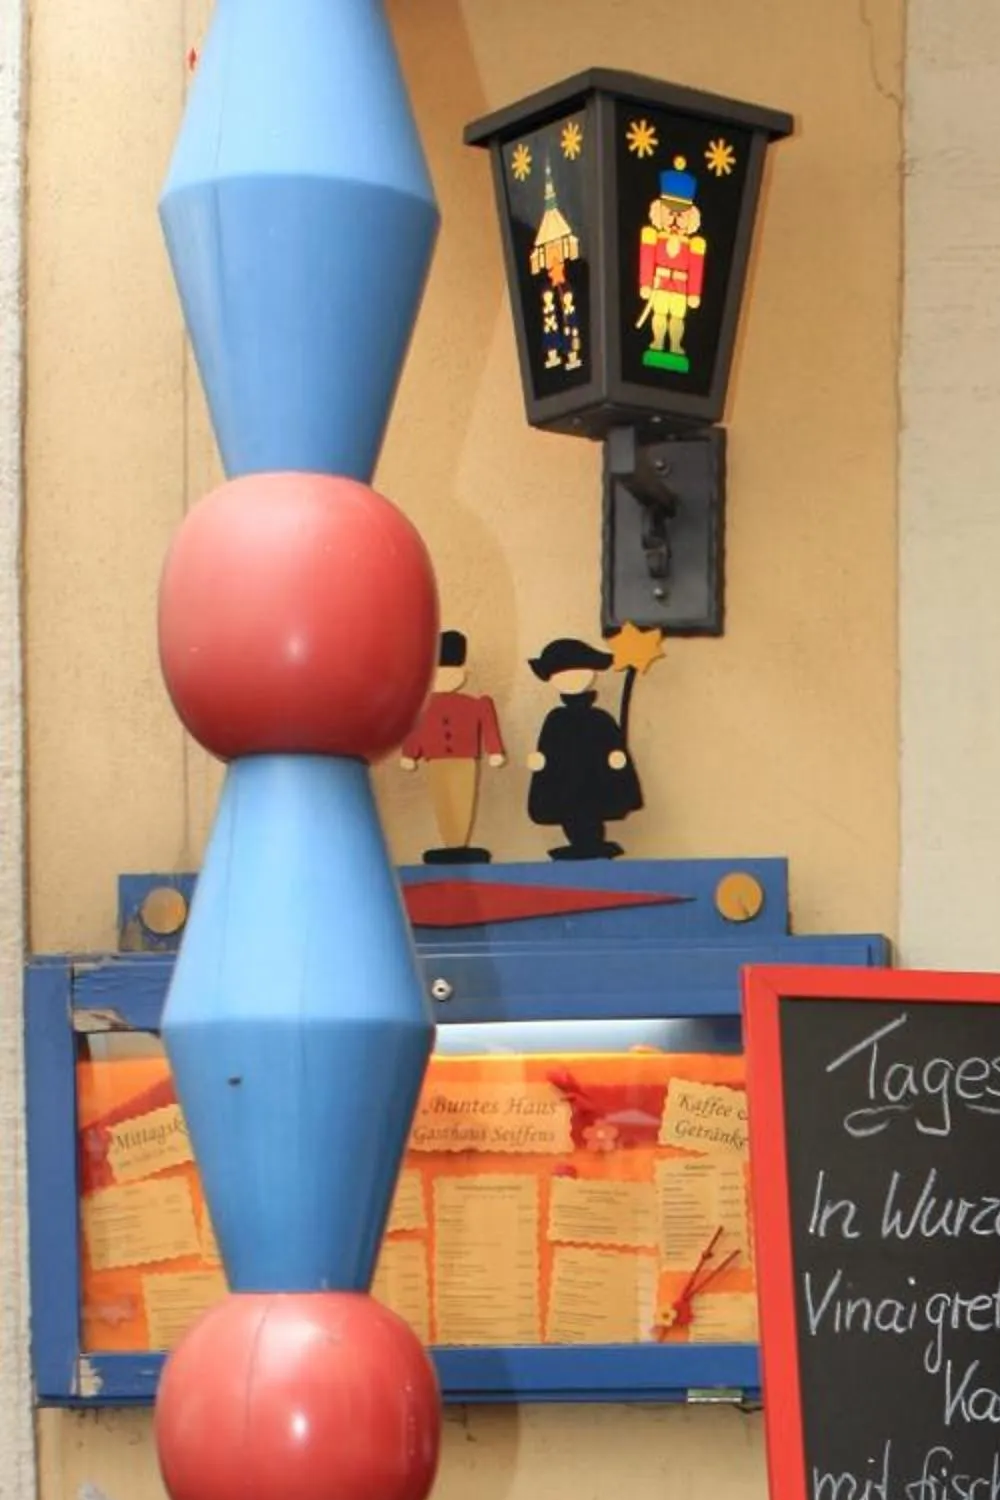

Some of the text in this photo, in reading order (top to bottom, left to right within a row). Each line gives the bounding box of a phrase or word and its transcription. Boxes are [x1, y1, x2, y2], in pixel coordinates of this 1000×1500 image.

[677, 1094, 734, 1119] Kaffee
[113, 1114, 189, 1153] Mittagsk
[808, 1169, 860, 1239] In
